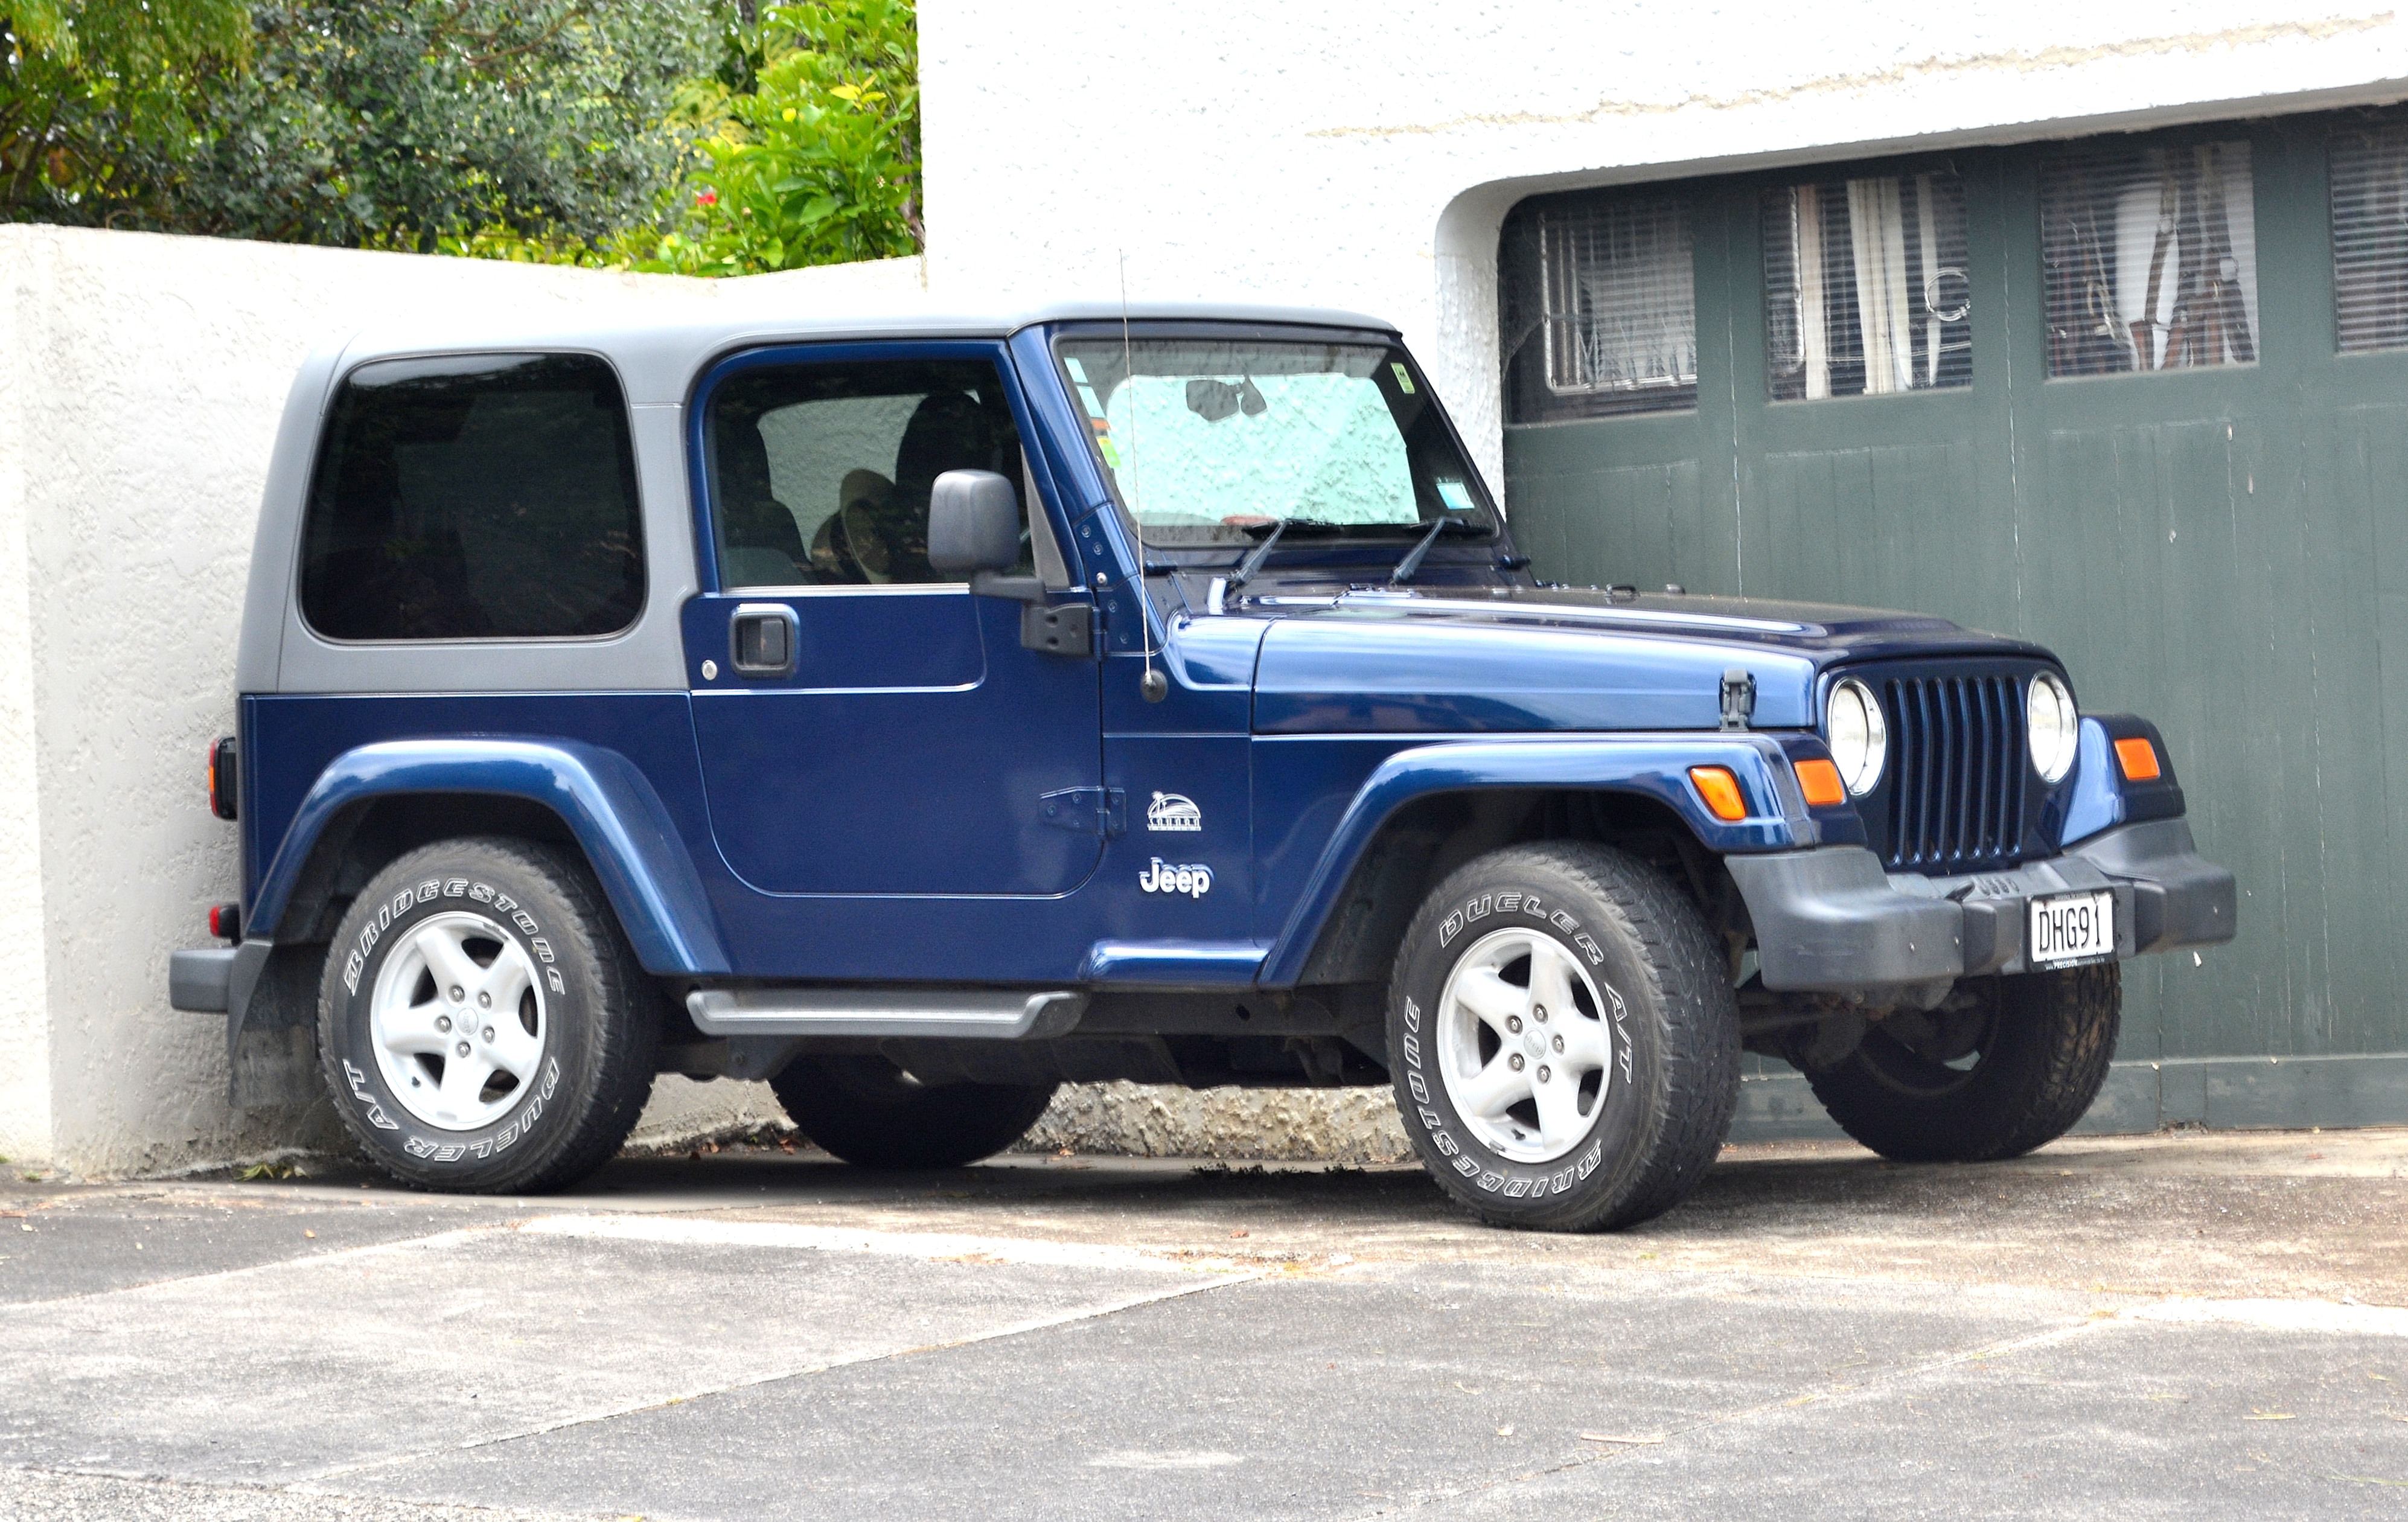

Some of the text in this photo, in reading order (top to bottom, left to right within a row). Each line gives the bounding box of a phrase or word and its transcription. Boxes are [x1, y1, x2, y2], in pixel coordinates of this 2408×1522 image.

[1139, 857, 1212, 898] Jeep
[2039, 905, 2101, 954] DHG91
[343, 877, 565, 996] BRIDGESTONE
[1438, 892, 1633, 1084] DUELER A/T
[342, 1057, 560, 1162] DUELER A/T
[1404, 995, 1602, 1198] BRIDGESTONE
